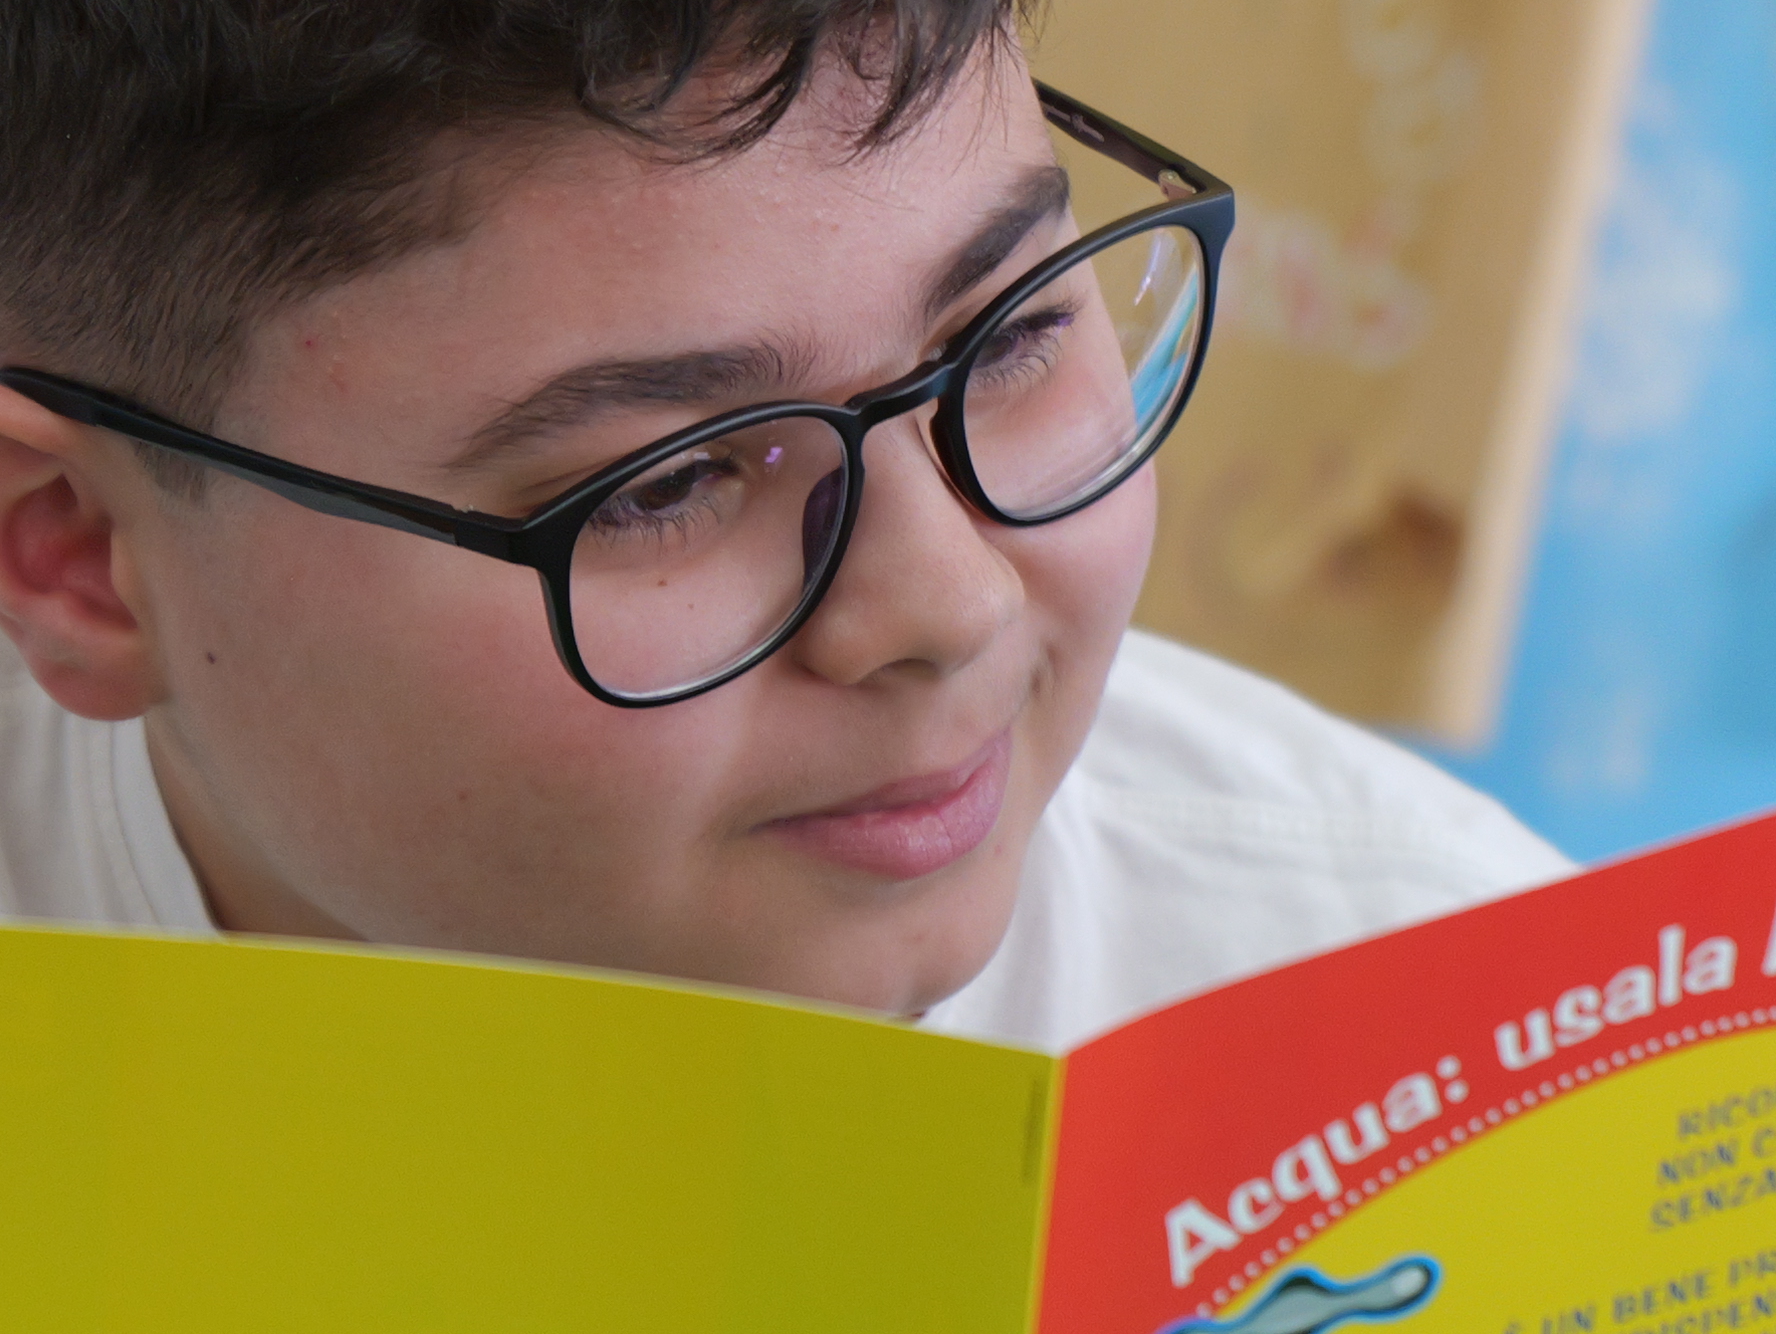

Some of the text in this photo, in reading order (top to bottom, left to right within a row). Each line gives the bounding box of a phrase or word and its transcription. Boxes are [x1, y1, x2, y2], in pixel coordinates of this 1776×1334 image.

[1162, 1054, 1470, 1287] Acqua:
[1494, 924, 1736, 1071] usala
[1657, 1142, 1739, 1189] NON
[1612, 1269, 1713, 1326] BENE
